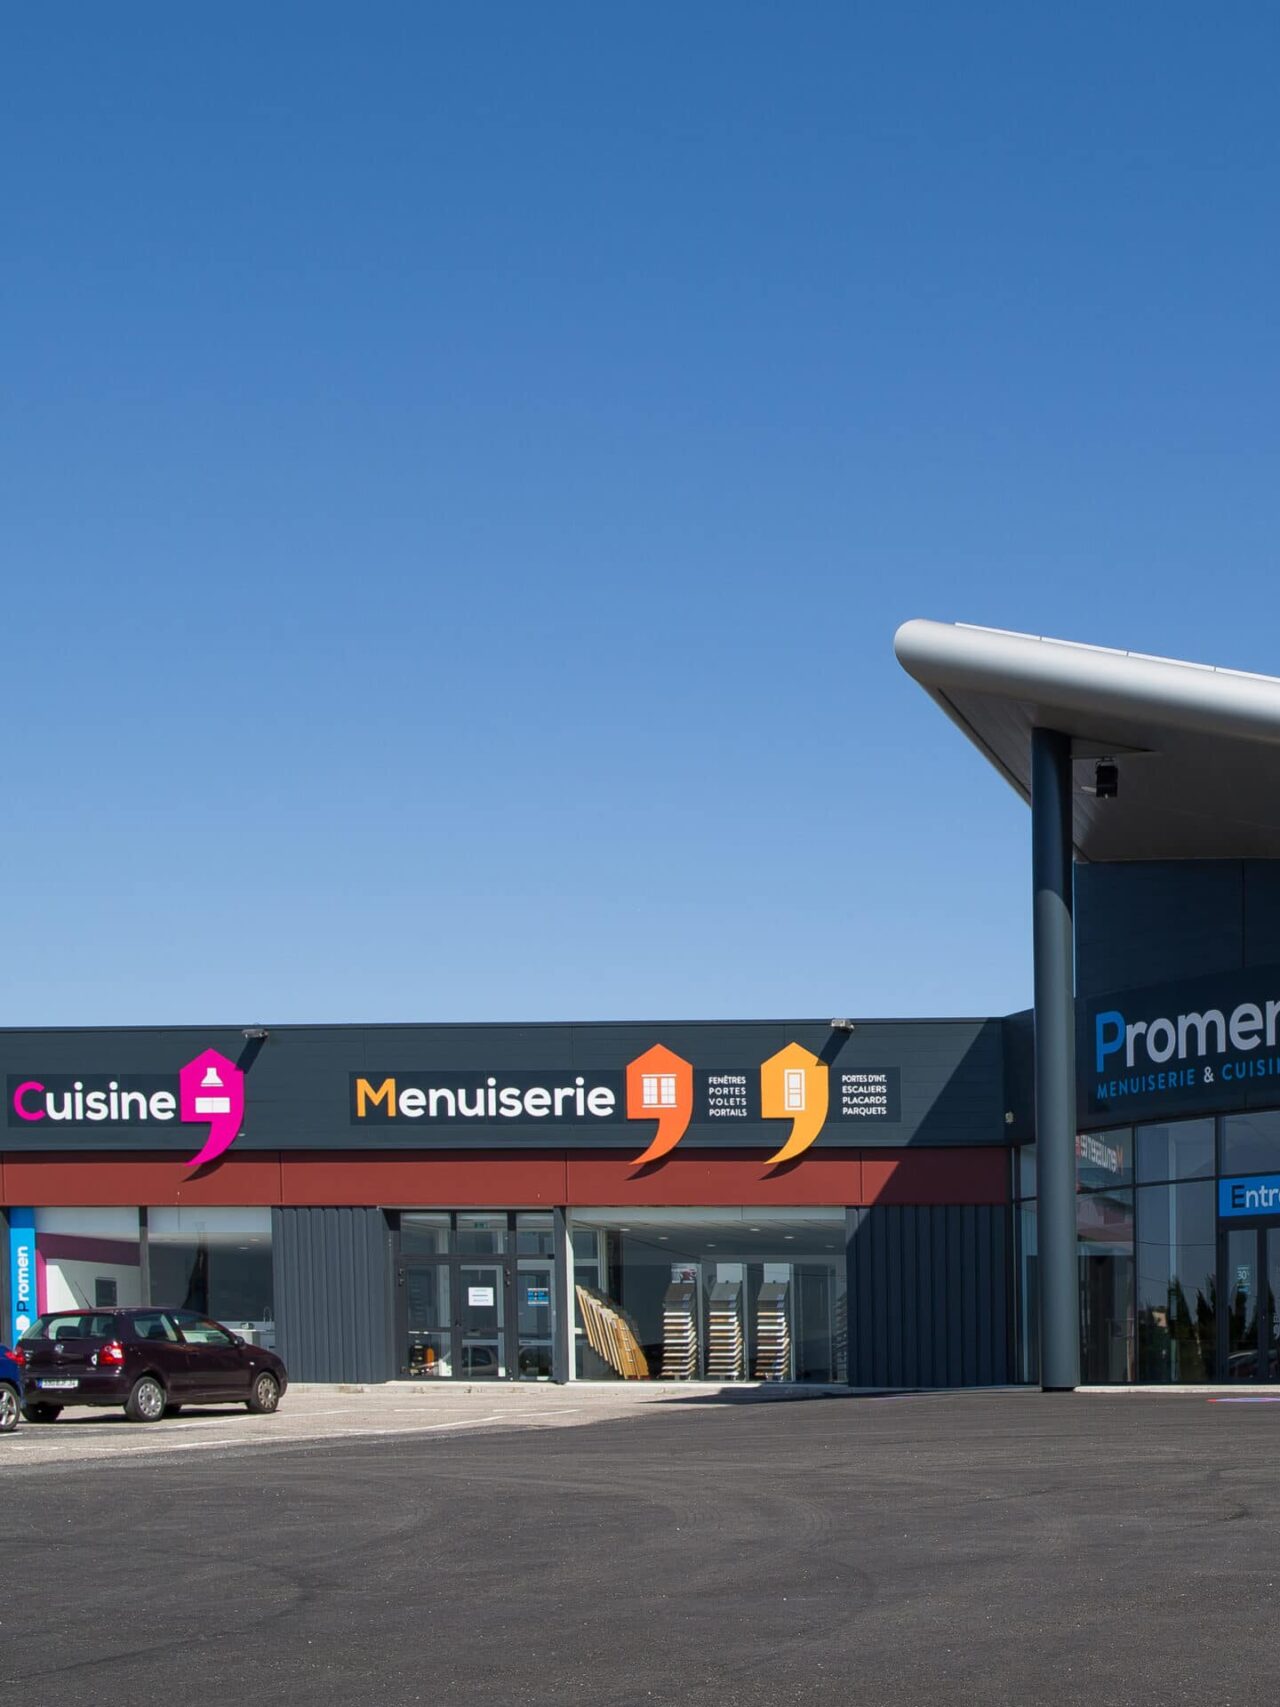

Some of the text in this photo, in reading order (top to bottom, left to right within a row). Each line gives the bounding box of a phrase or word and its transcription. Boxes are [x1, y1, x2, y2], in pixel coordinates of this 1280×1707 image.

[708, 1074, 747, 1085] FENÊTRES
[841, 1074, 867, 1083] PORTES
[1097, 1068, 1196, 1100] MENUISERIE
[1203, 1066, 1215, 1083] &
[708, 1086, 747, 1095] PORTES
[842, 1085, 887, 1094] ESCALIERS
[13, 1081, 177, 1121] Cuisine
[356, 1077, 616, 1118] Menuiserie
[708, 1097, 747, 1106] VOLETS
[842, 1096, 888, 1105] PLACARDS
[708, 1108, 748, 1117] PORTAILS
[842, 1106, 887, 1117] PARQUETS
[16, 1245, 29, 1312] Promen
